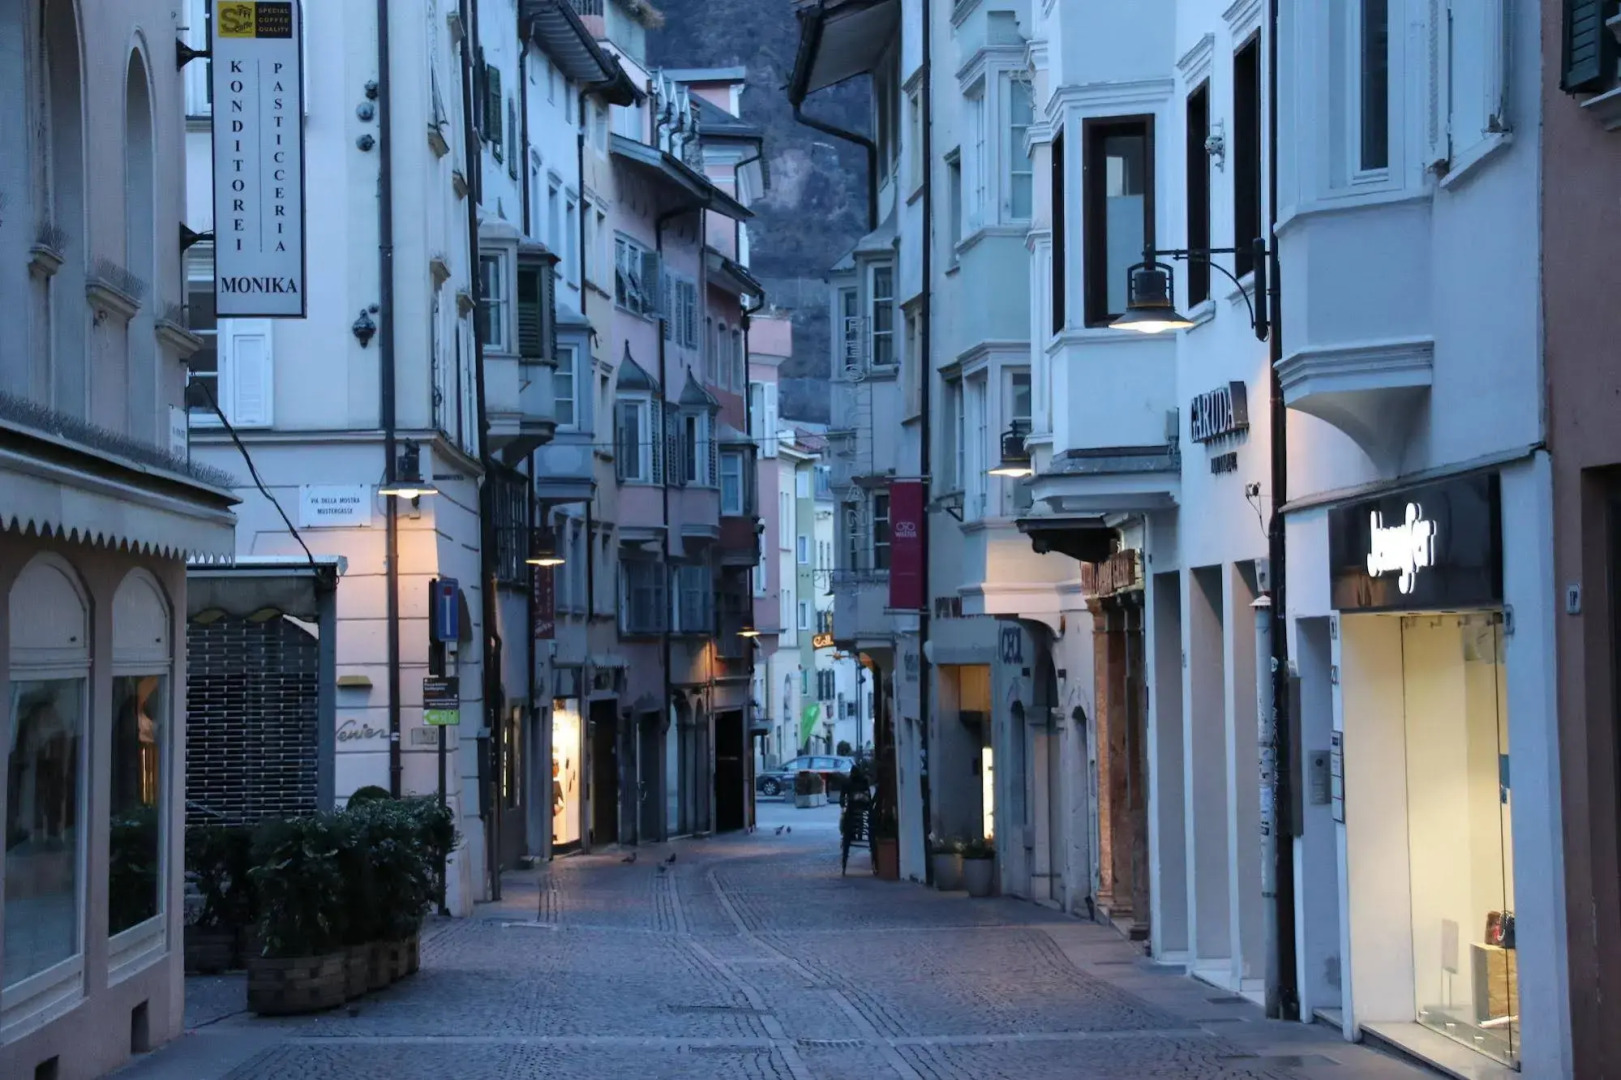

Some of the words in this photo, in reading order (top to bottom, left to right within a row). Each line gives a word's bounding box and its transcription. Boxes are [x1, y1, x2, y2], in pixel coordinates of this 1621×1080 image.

[230, 60, 244, 251] KONDITOREI
[274, 62, 286, 252] PASTICCERIA
[221, 277, 298, 294] MONIKA
[339, 496, 360, 504] MOSTRA
